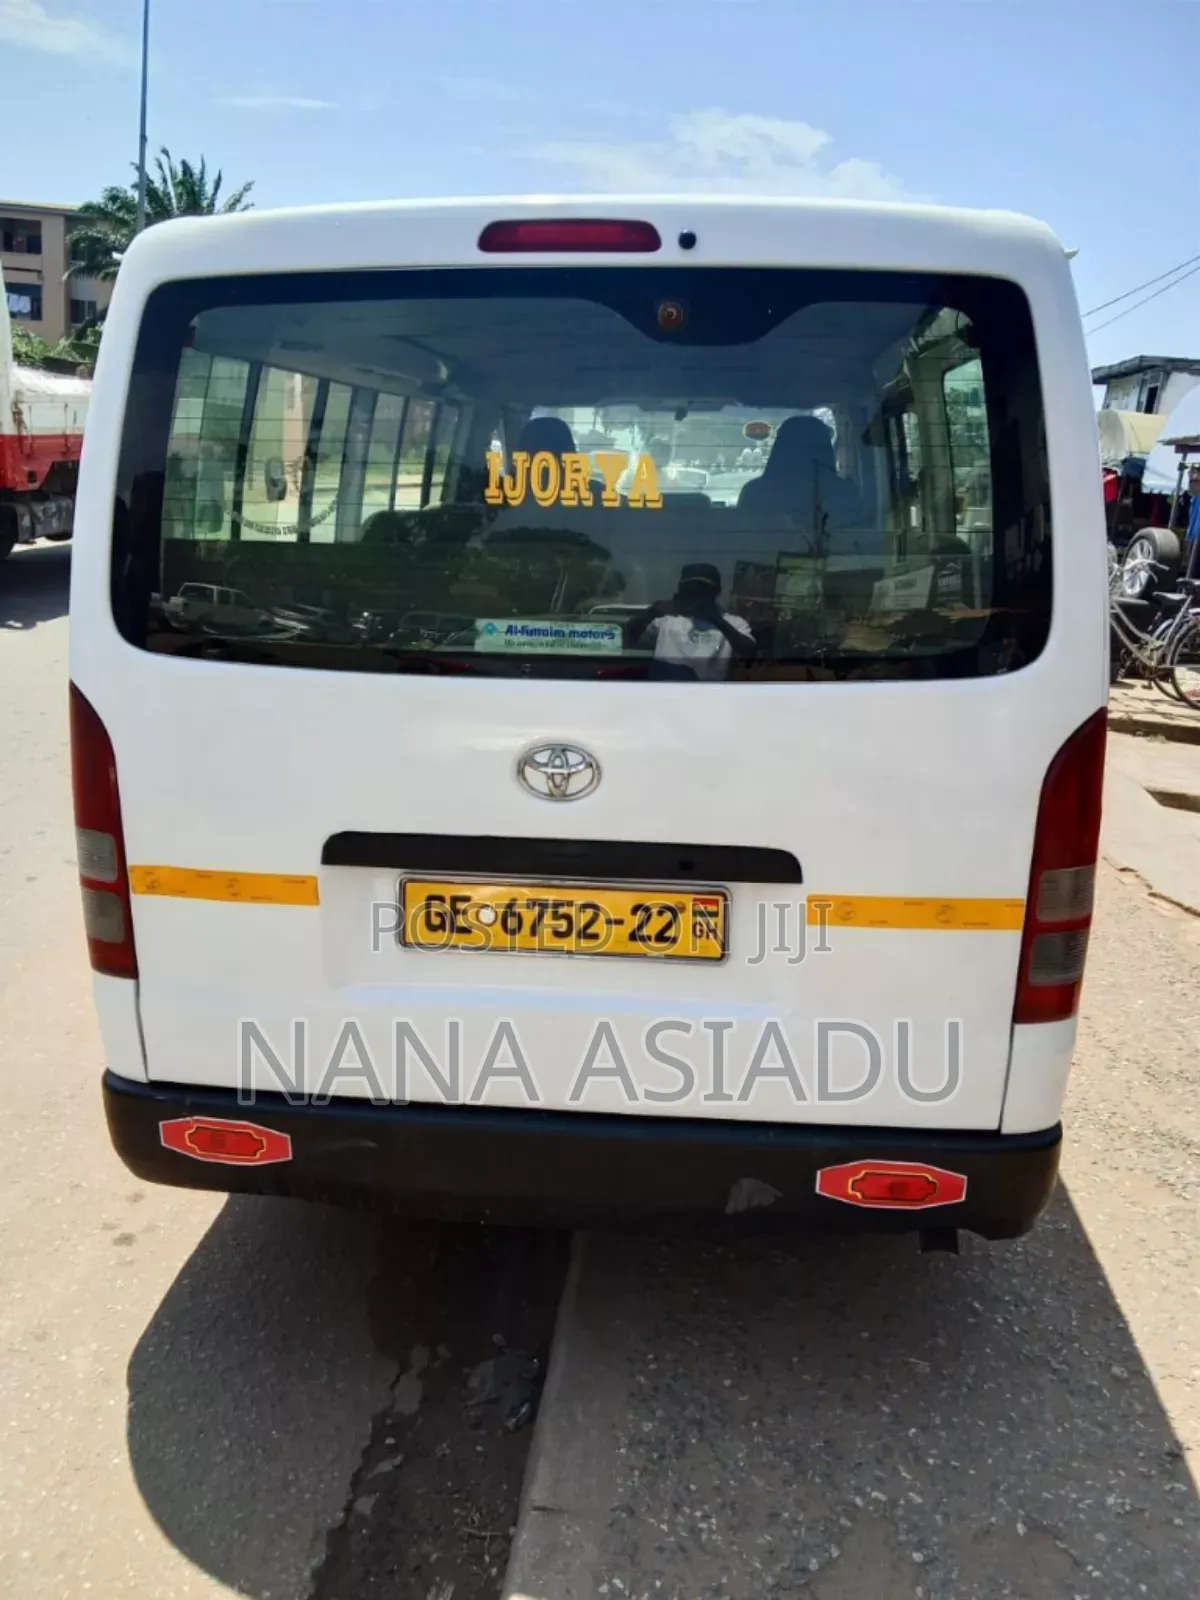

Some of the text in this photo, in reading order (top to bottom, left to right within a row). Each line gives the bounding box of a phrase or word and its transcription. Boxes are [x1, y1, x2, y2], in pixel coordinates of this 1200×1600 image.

[568, 628, 616, 640] motors
[424, 895, 473, 934] GE
[501, 897, 678, 943] 6752-22
